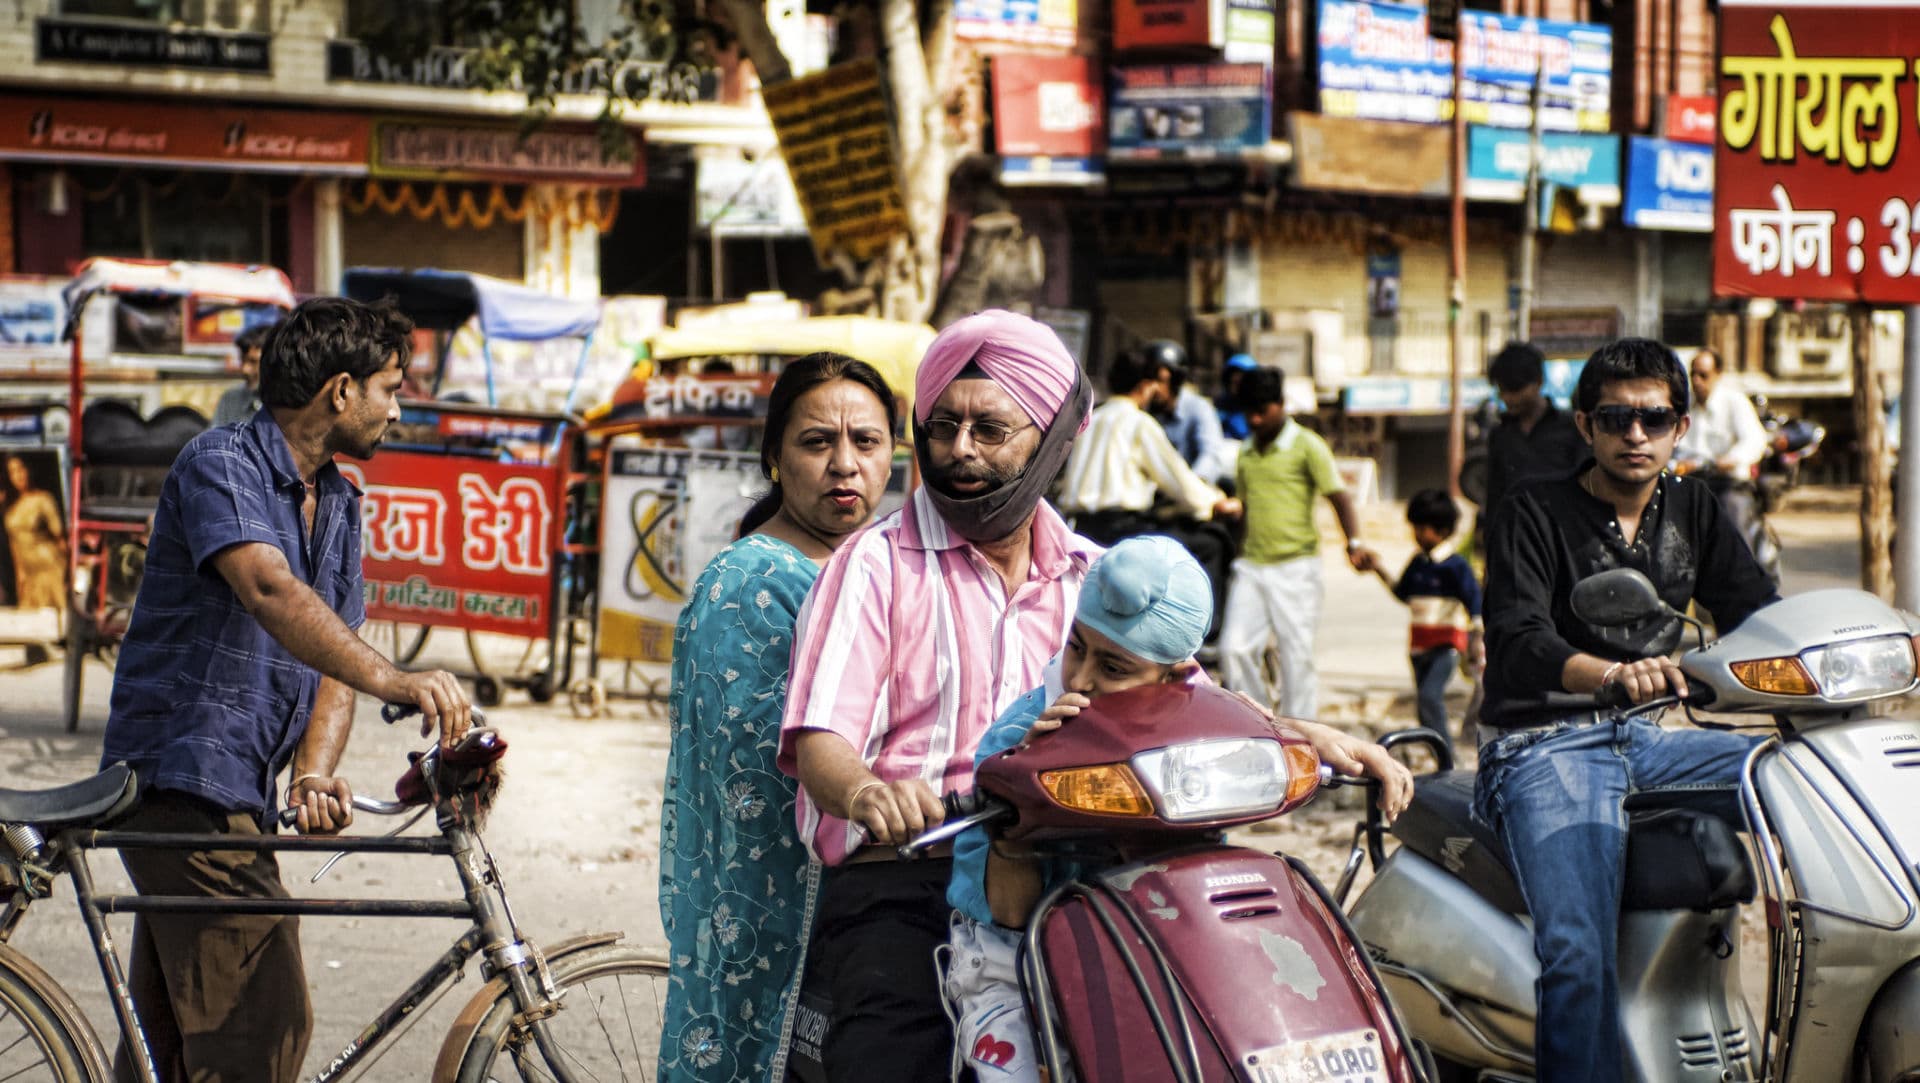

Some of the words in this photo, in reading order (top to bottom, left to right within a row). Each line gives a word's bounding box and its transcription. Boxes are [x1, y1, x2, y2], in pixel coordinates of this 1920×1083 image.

[1721, 14, 1907, 169] गोयल
[1729, 183, 1836, 277] फोन
[458, 472, 553, 576] डेरी
[1205, 872, 1267, 888] HONDA
